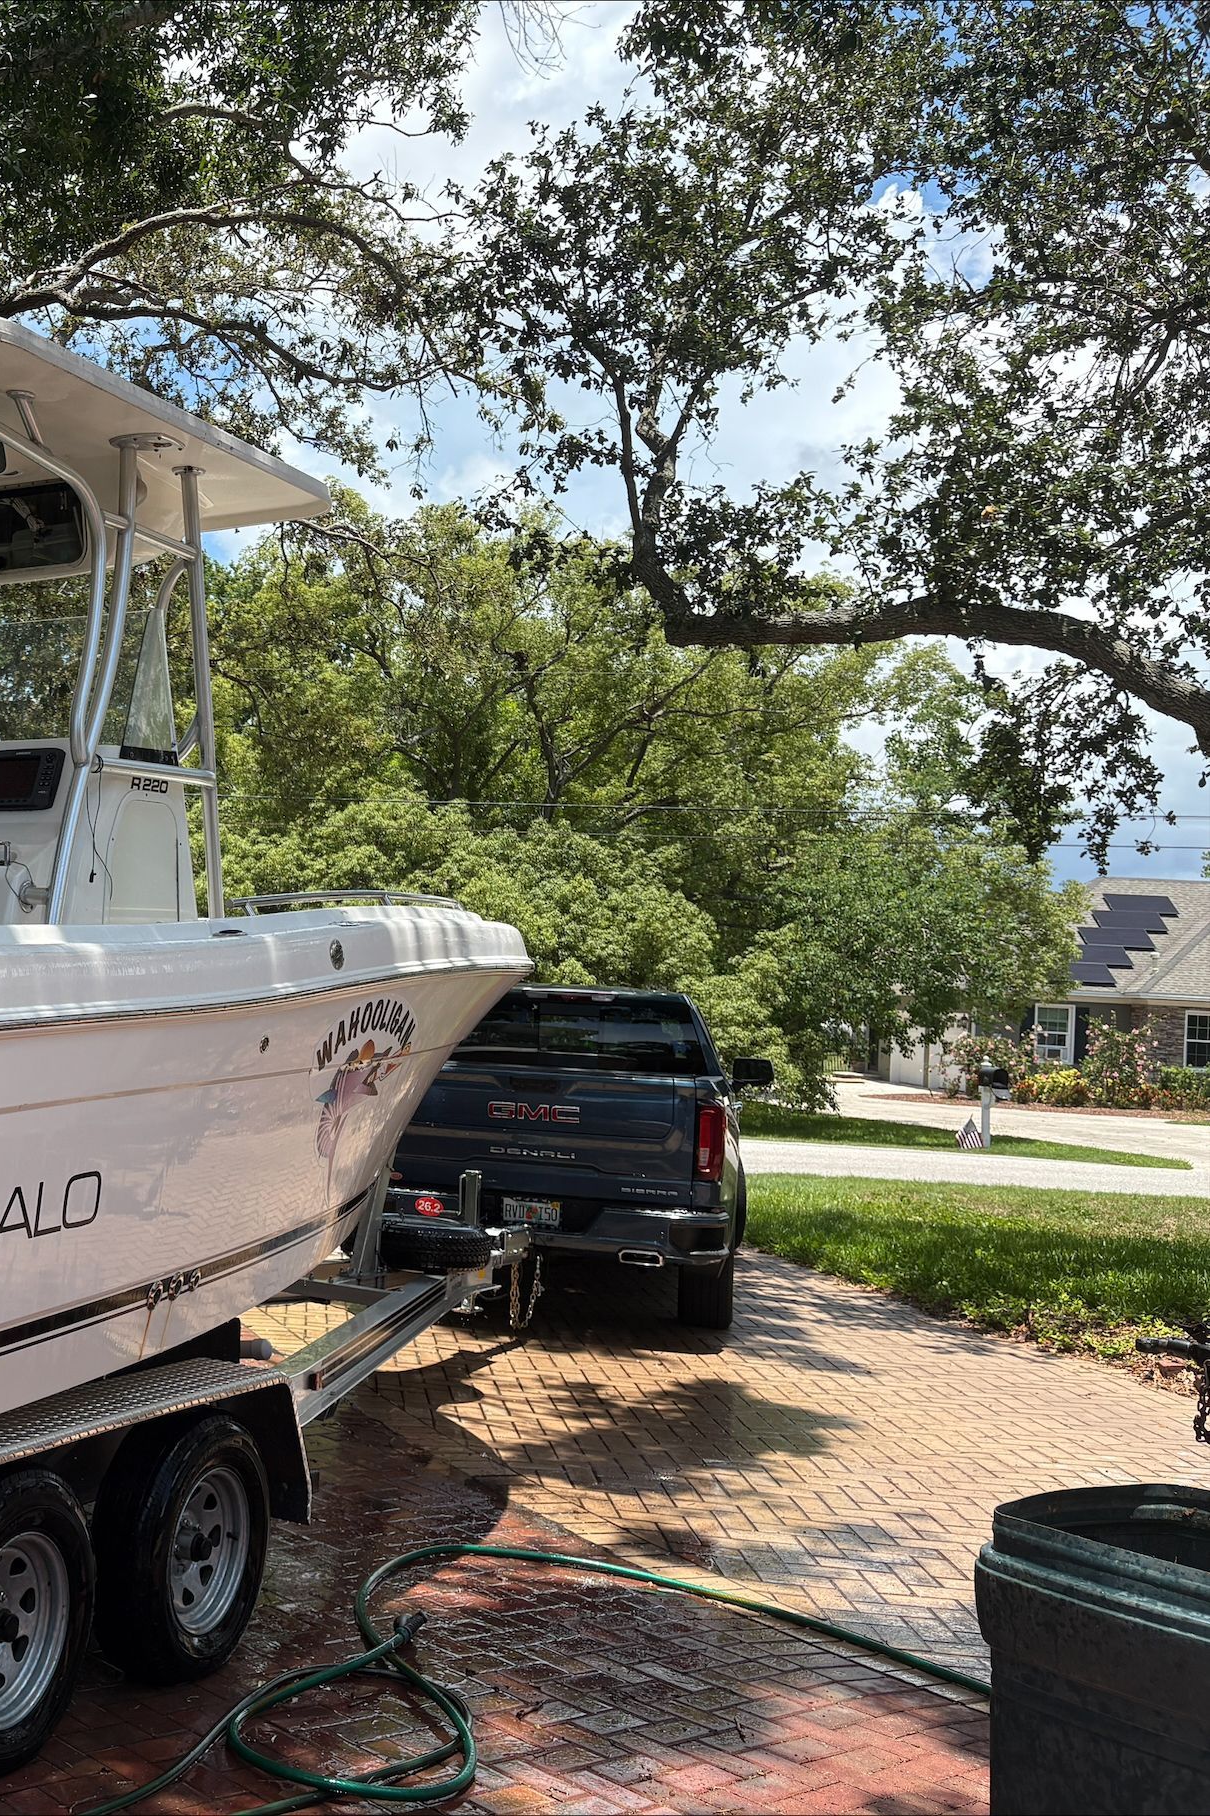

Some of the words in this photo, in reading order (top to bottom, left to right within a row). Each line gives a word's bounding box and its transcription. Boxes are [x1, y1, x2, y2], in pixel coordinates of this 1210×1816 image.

[316, 999, 416, 1072] WAHOOLIGAN
[488, 1101, 580, 1123] GMC
[490, 1146, 577, 1160] DENALI
[418, 1200, 441, 1213] 26.2
